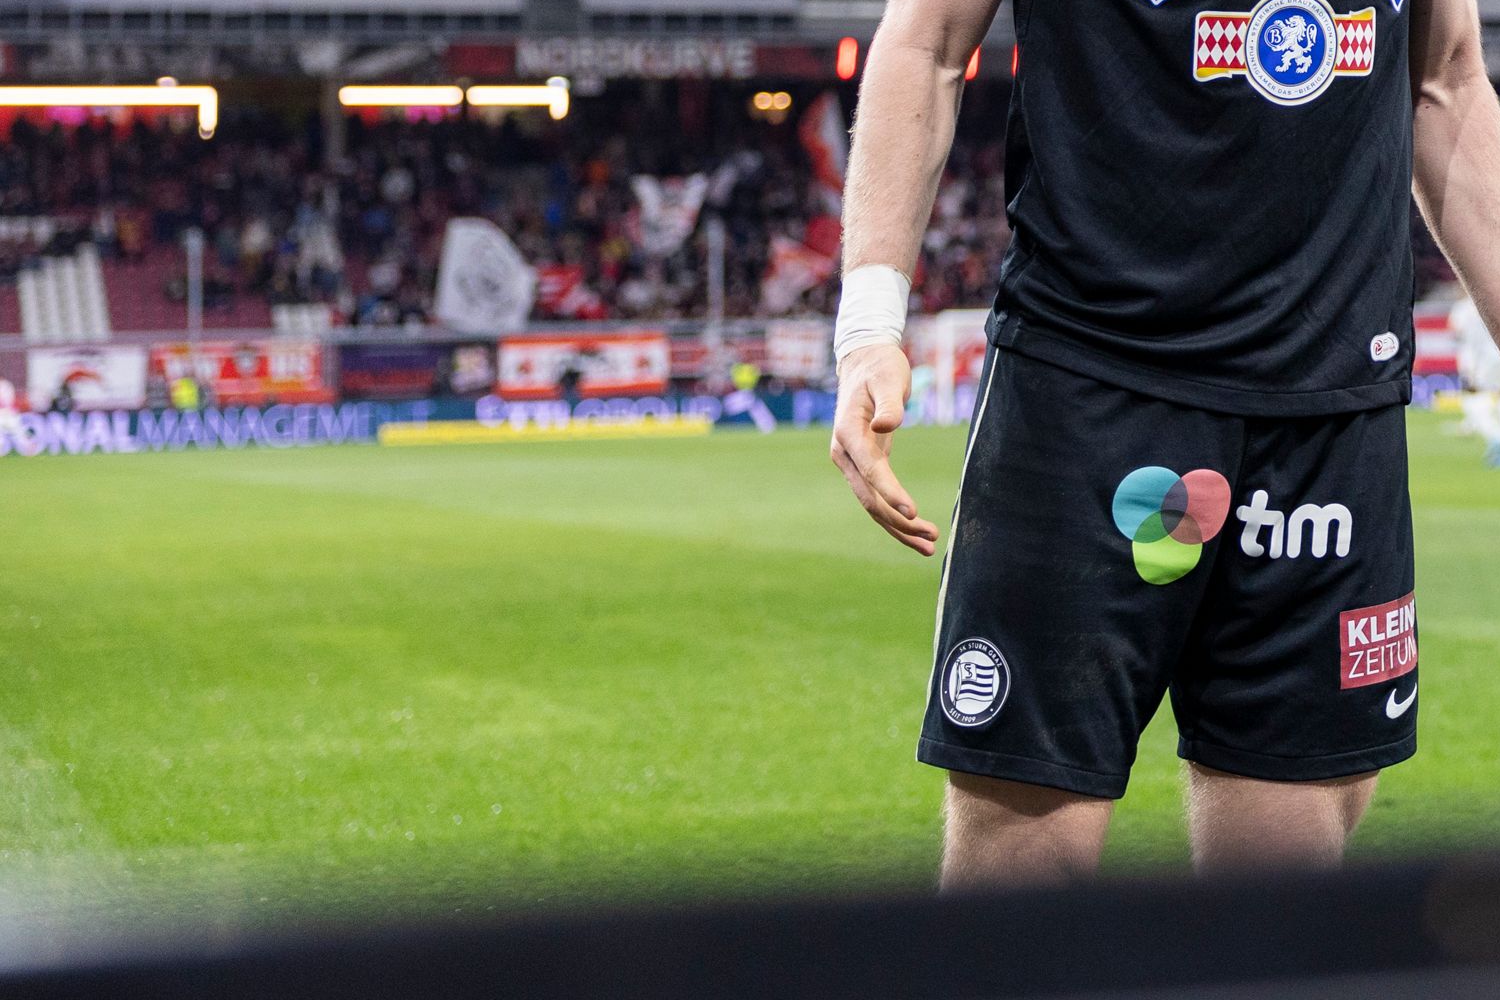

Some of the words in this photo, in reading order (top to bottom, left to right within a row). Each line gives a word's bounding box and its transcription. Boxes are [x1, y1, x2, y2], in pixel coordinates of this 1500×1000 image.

[1251, 0, 1285, 37] STEIRISCHE
[1249, 45, 1276, 92] PUNTIGAMER
[1277, 88, 1292, 96] DAS
[1236, 489, 1353, 560] tim
[968, 642, 988, 652] STURM
[987, 649, 1003, 668] GRAZ
[948, 707, 961, 720] SEIT
